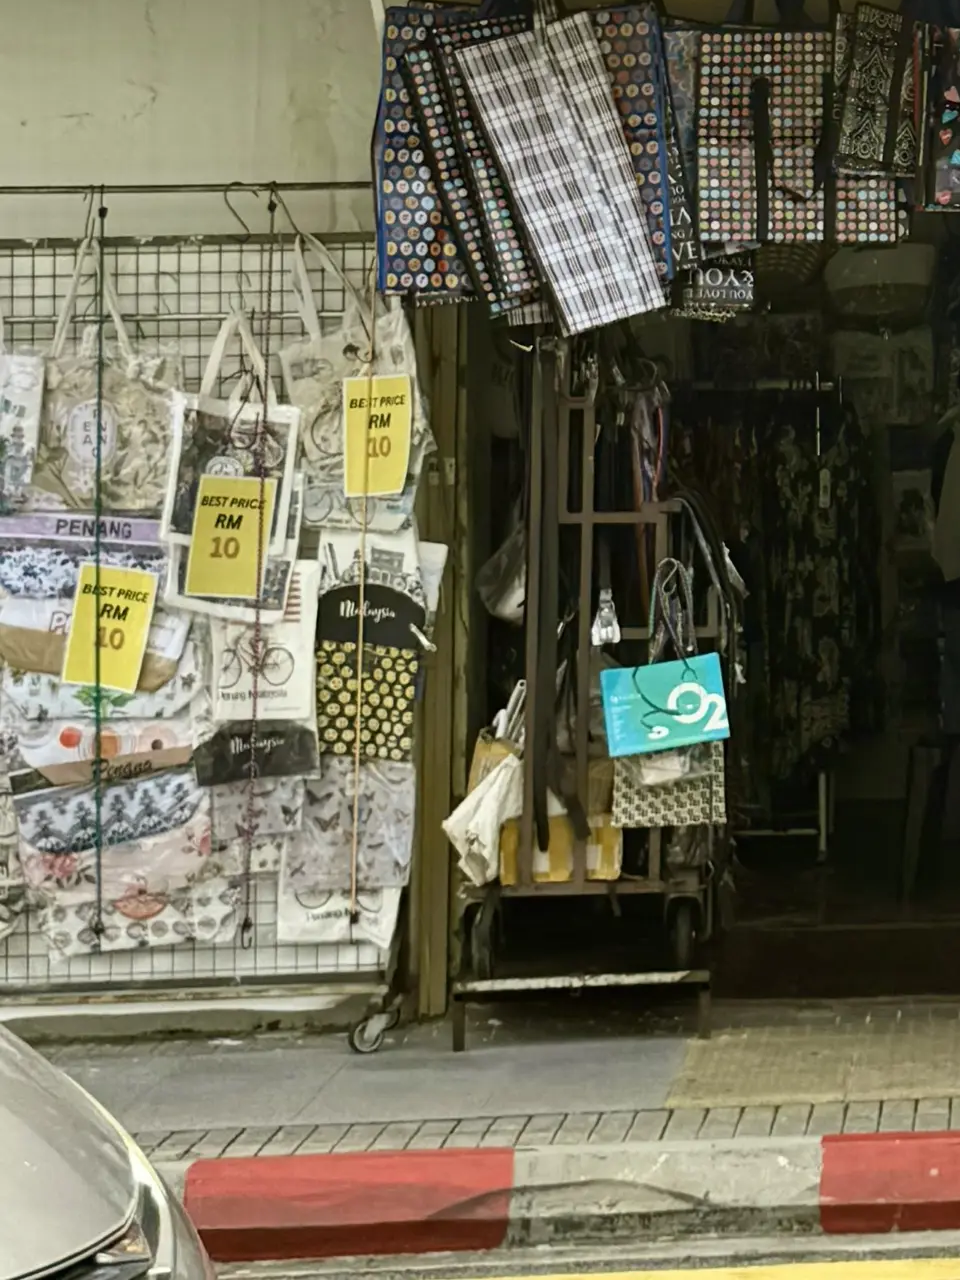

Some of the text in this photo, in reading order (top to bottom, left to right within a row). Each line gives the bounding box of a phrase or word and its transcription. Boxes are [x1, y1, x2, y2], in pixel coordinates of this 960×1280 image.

[379, 394, 406, 407] PRICE
[368, 413, 391, 429] RM
[368, 437, 391, 458] 10
[201, 496, 228, 508] BEST
[55, 519, 132, 539] PENANG
[214, 514, 243, 530] RM
[209, 537, 240, 559] 10
[117, 588, 150, 604] PRICE
[101, 604, 129, 621] RM
[97, 627, 126, 650] 10
